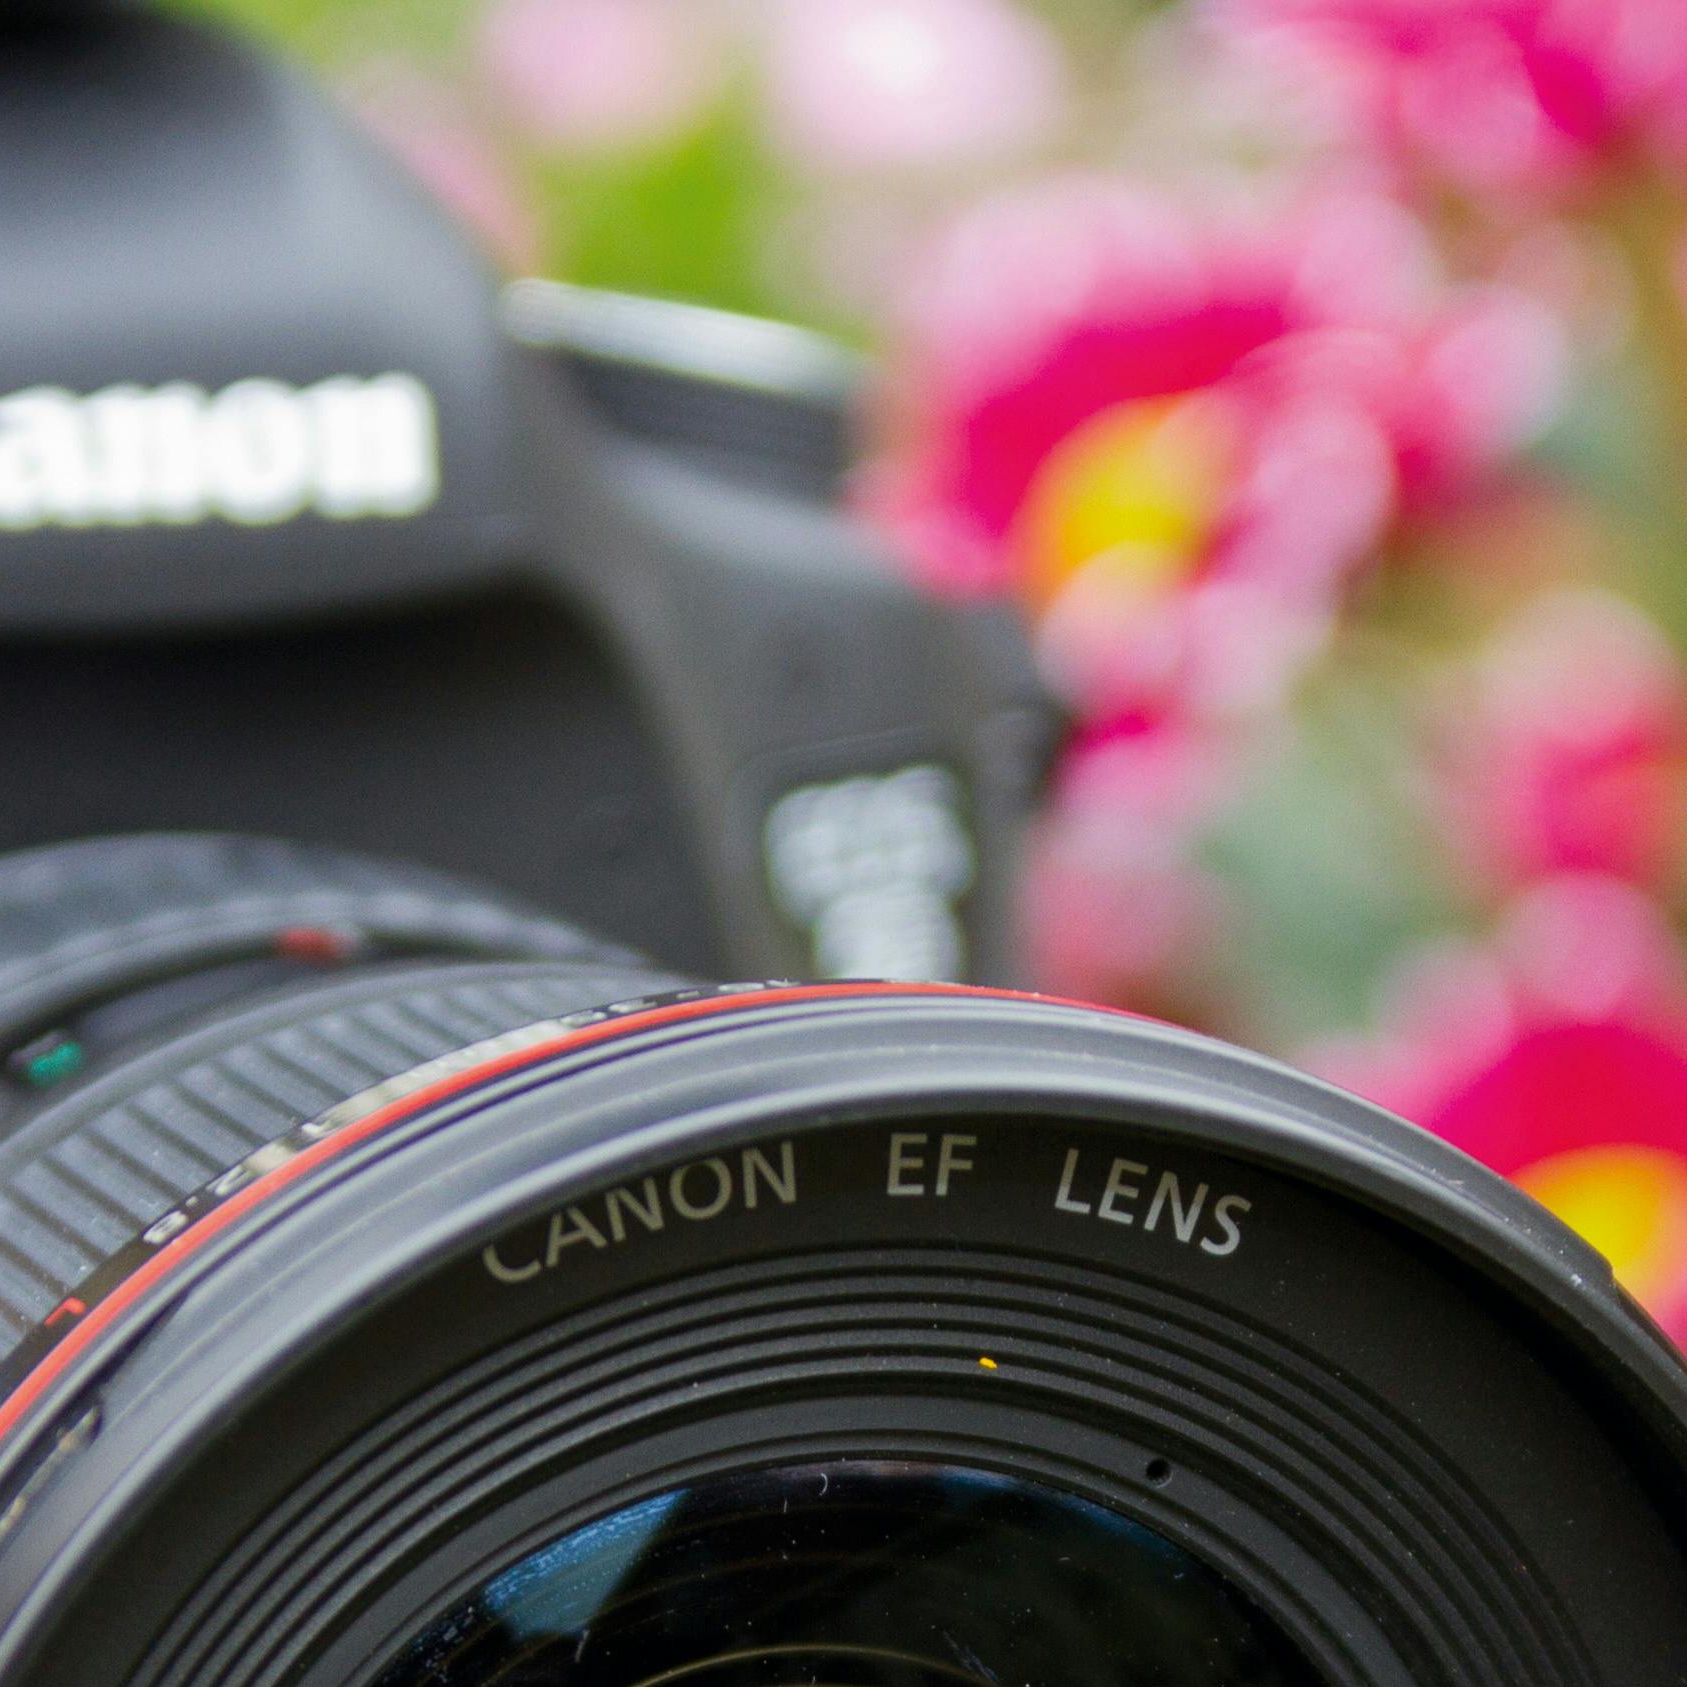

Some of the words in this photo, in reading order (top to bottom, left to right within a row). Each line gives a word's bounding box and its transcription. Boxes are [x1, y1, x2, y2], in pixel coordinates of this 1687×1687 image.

[482, 1141, 797, 1283] CANON
[886, 1132, 978, 1197] EF
[1053, 1148, 1252, 1256] LENS
